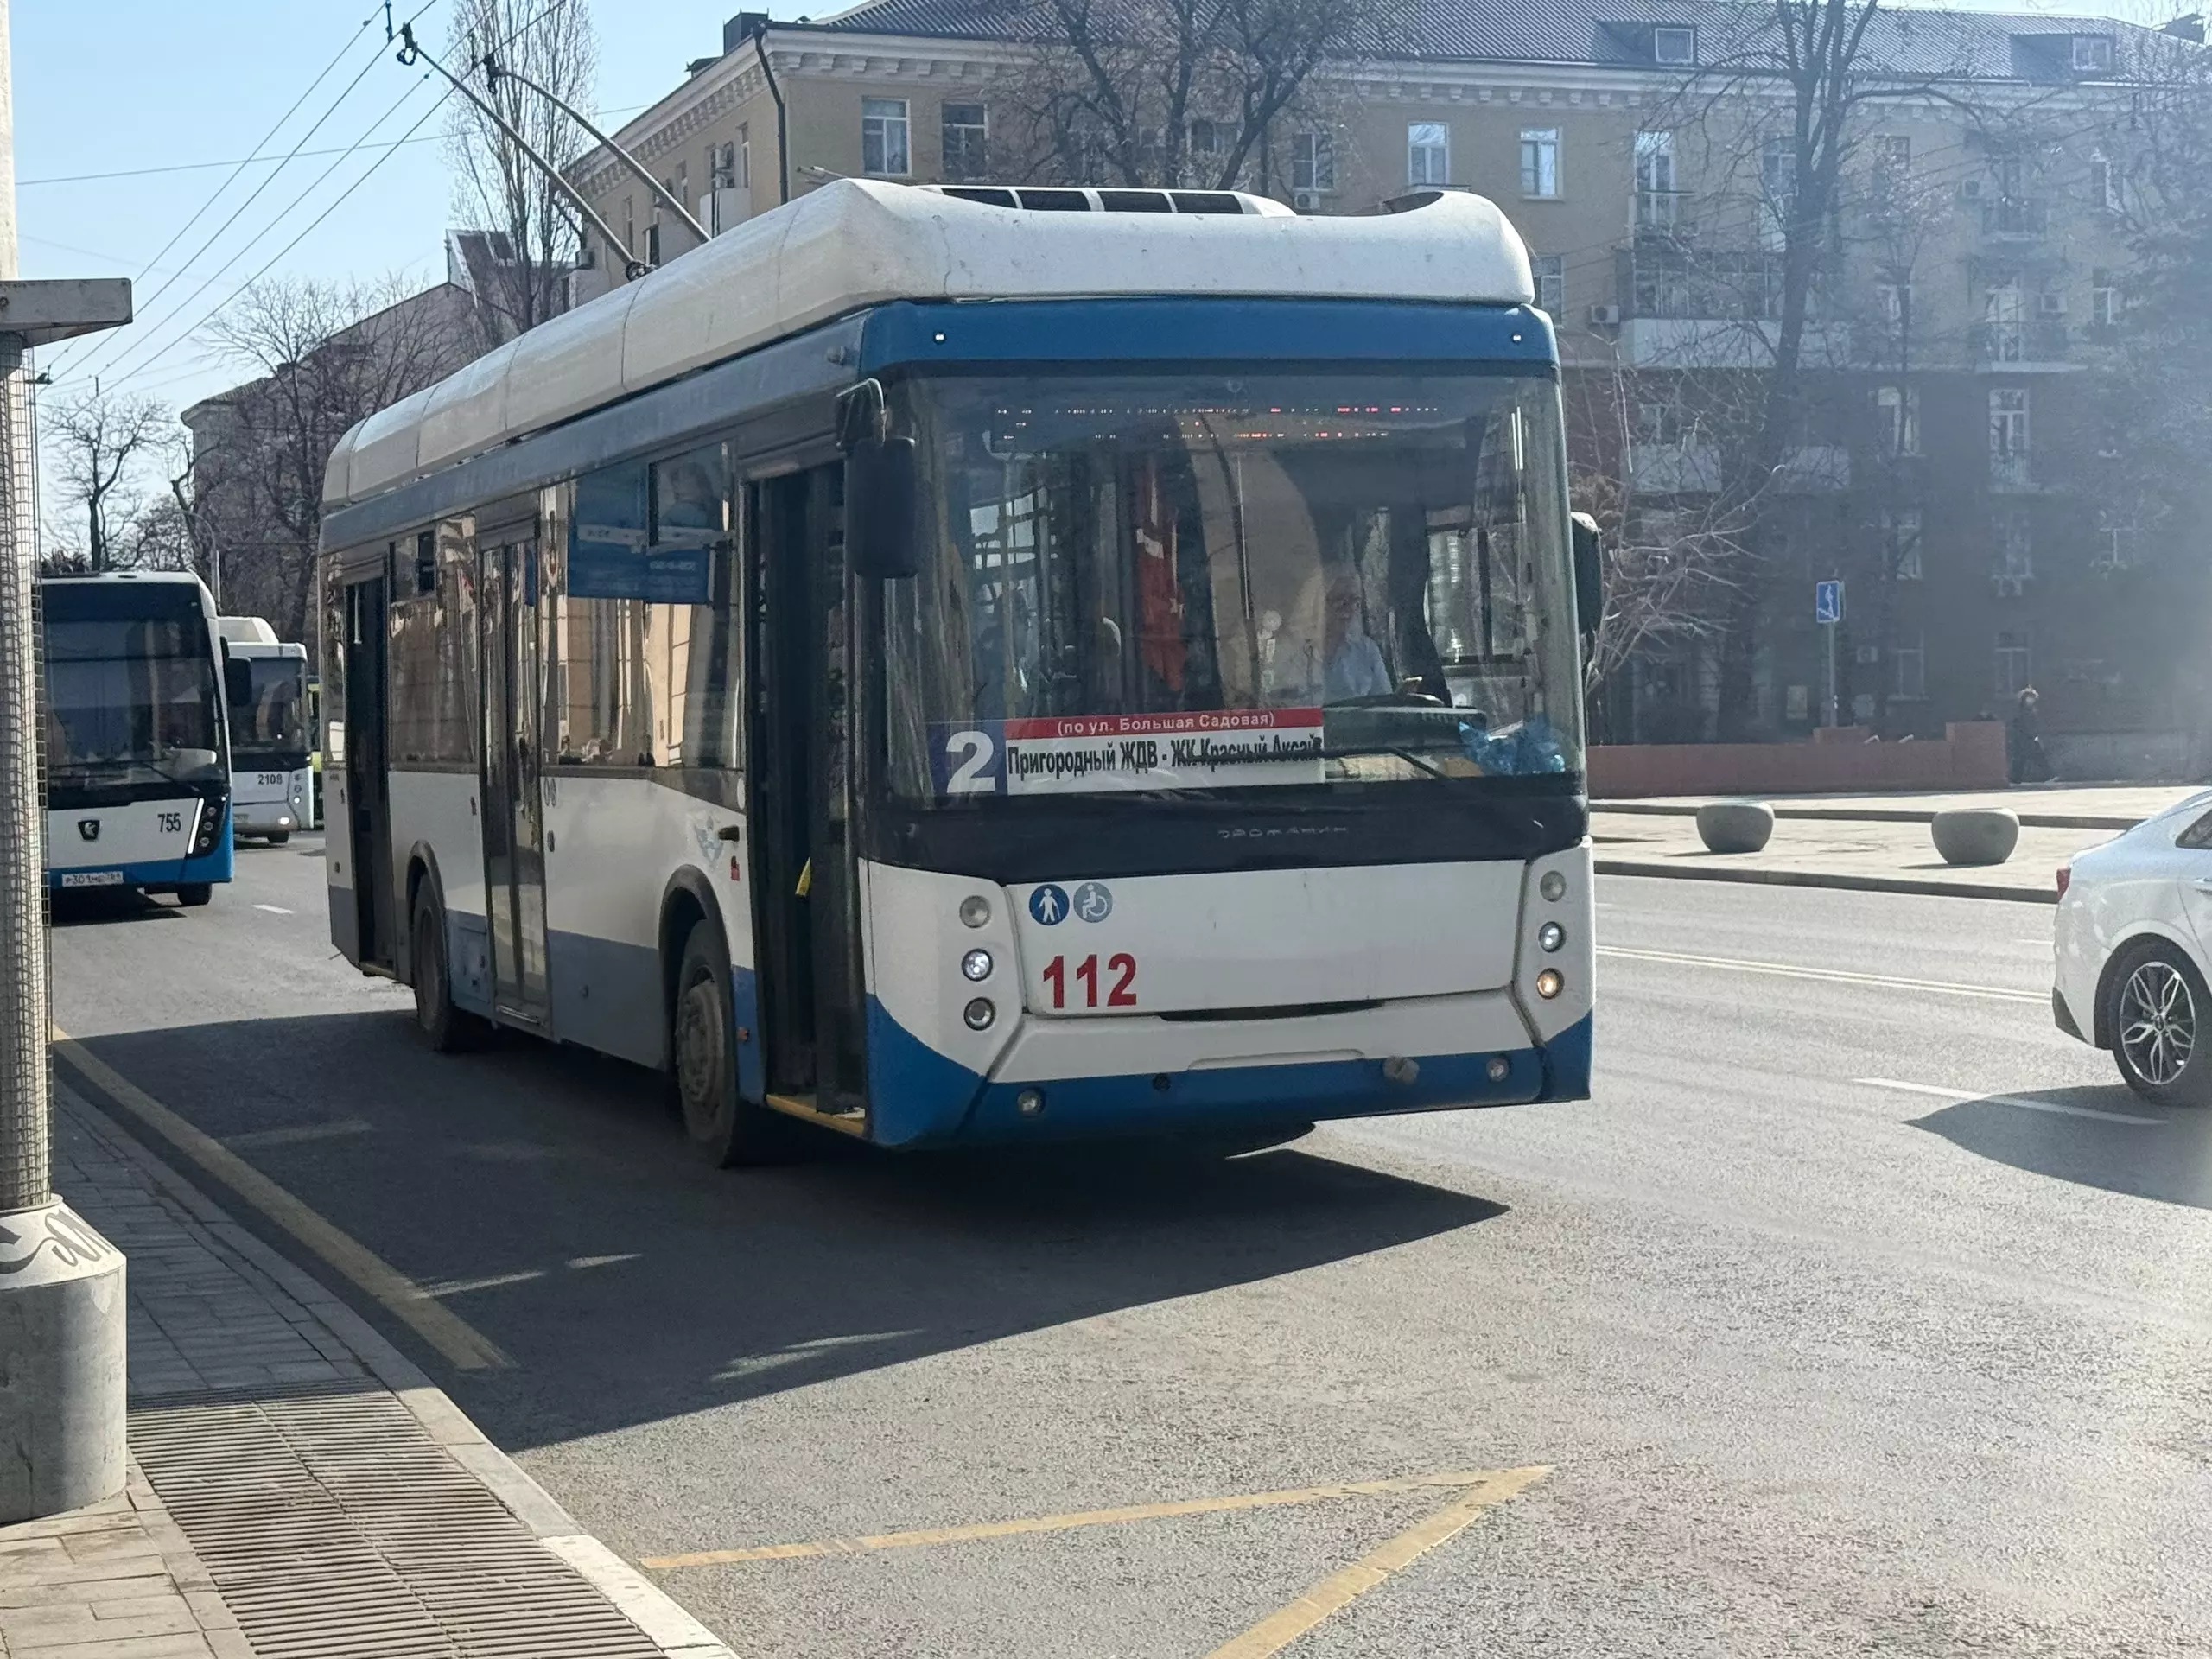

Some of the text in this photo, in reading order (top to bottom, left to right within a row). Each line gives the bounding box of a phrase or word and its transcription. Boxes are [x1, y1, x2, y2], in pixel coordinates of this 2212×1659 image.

[1058, 712, 1274, 736] (по ул. Большая Садовая)
[946, 731, 995, 793] 2
[1007, 741, 1116, 781] Пригородный
[1120, 741, 1159, 774] ЖДВ
[258, 774, 283, 785] 2108
[157, 812, 181, 832] 755
[1043, 953, 1137, 1009] 112
